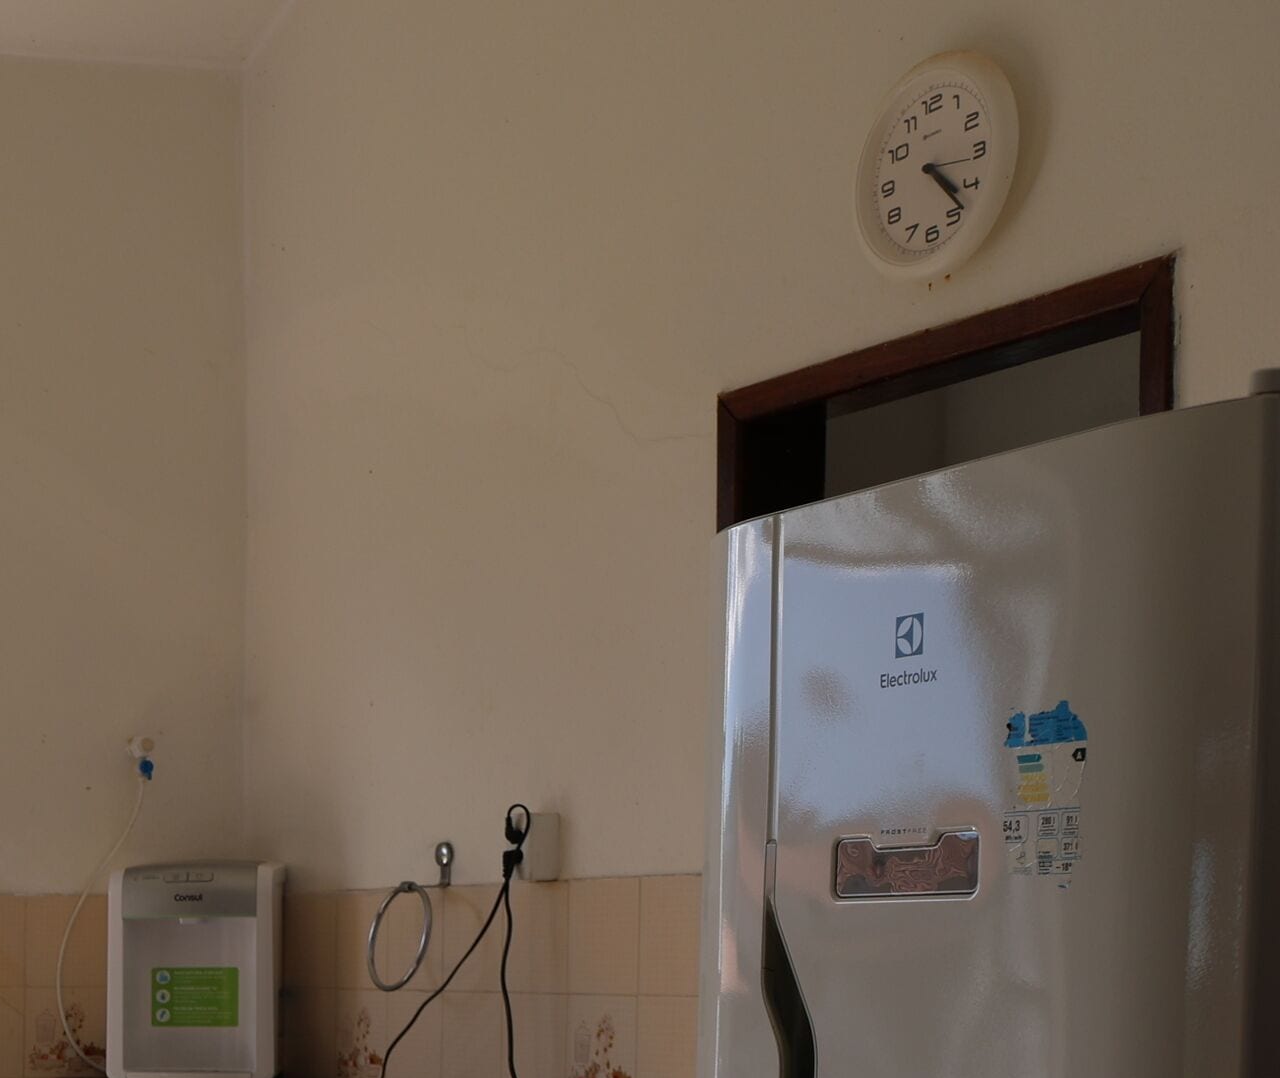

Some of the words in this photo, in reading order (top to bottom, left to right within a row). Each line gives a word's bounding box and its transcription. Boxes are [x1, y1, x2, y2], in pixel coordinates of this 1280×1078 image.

[922, 93, 943, 115] 12
[952, 94, 960, 110] 1
[904, 116, 918, 133] 11
[964, 111, 980, 132] 2
[888, 143, 909, 164] 10
[973, 140, 986, 160] 3
[881, 180, 895, 198] 9
[963, 177, 980, 190] 4
[888, 207, 901, 225] 8
[946, 206, 961, 227] 5
[905, 223, 920, 243] 7
[926, 225, 940, 243] 6
[880, 667, 938, 689] Electrolux
[174, 892, 203, 902] Consul
